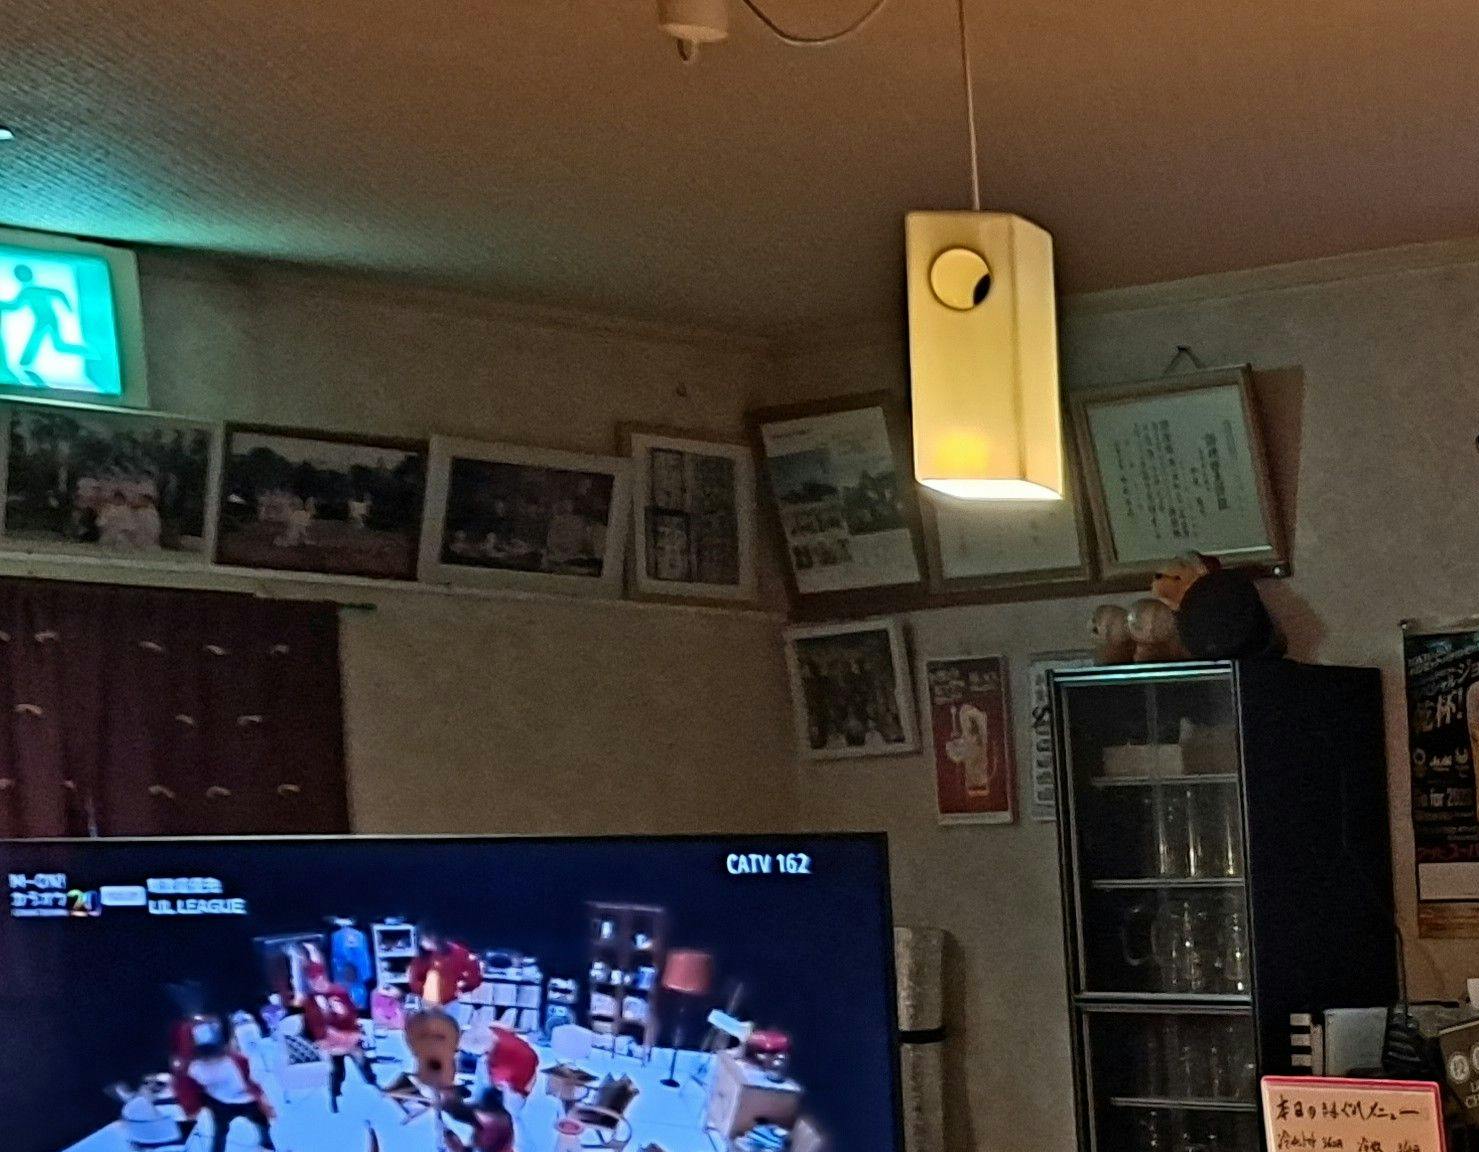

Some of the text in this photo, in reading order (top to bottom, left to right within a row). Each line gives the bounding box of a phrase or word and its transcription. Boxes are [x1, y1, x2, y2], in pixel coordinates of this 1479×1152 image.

[727, 853, 812, 874] CATV 162
[177, 898, 248, 915] LEAGUE
